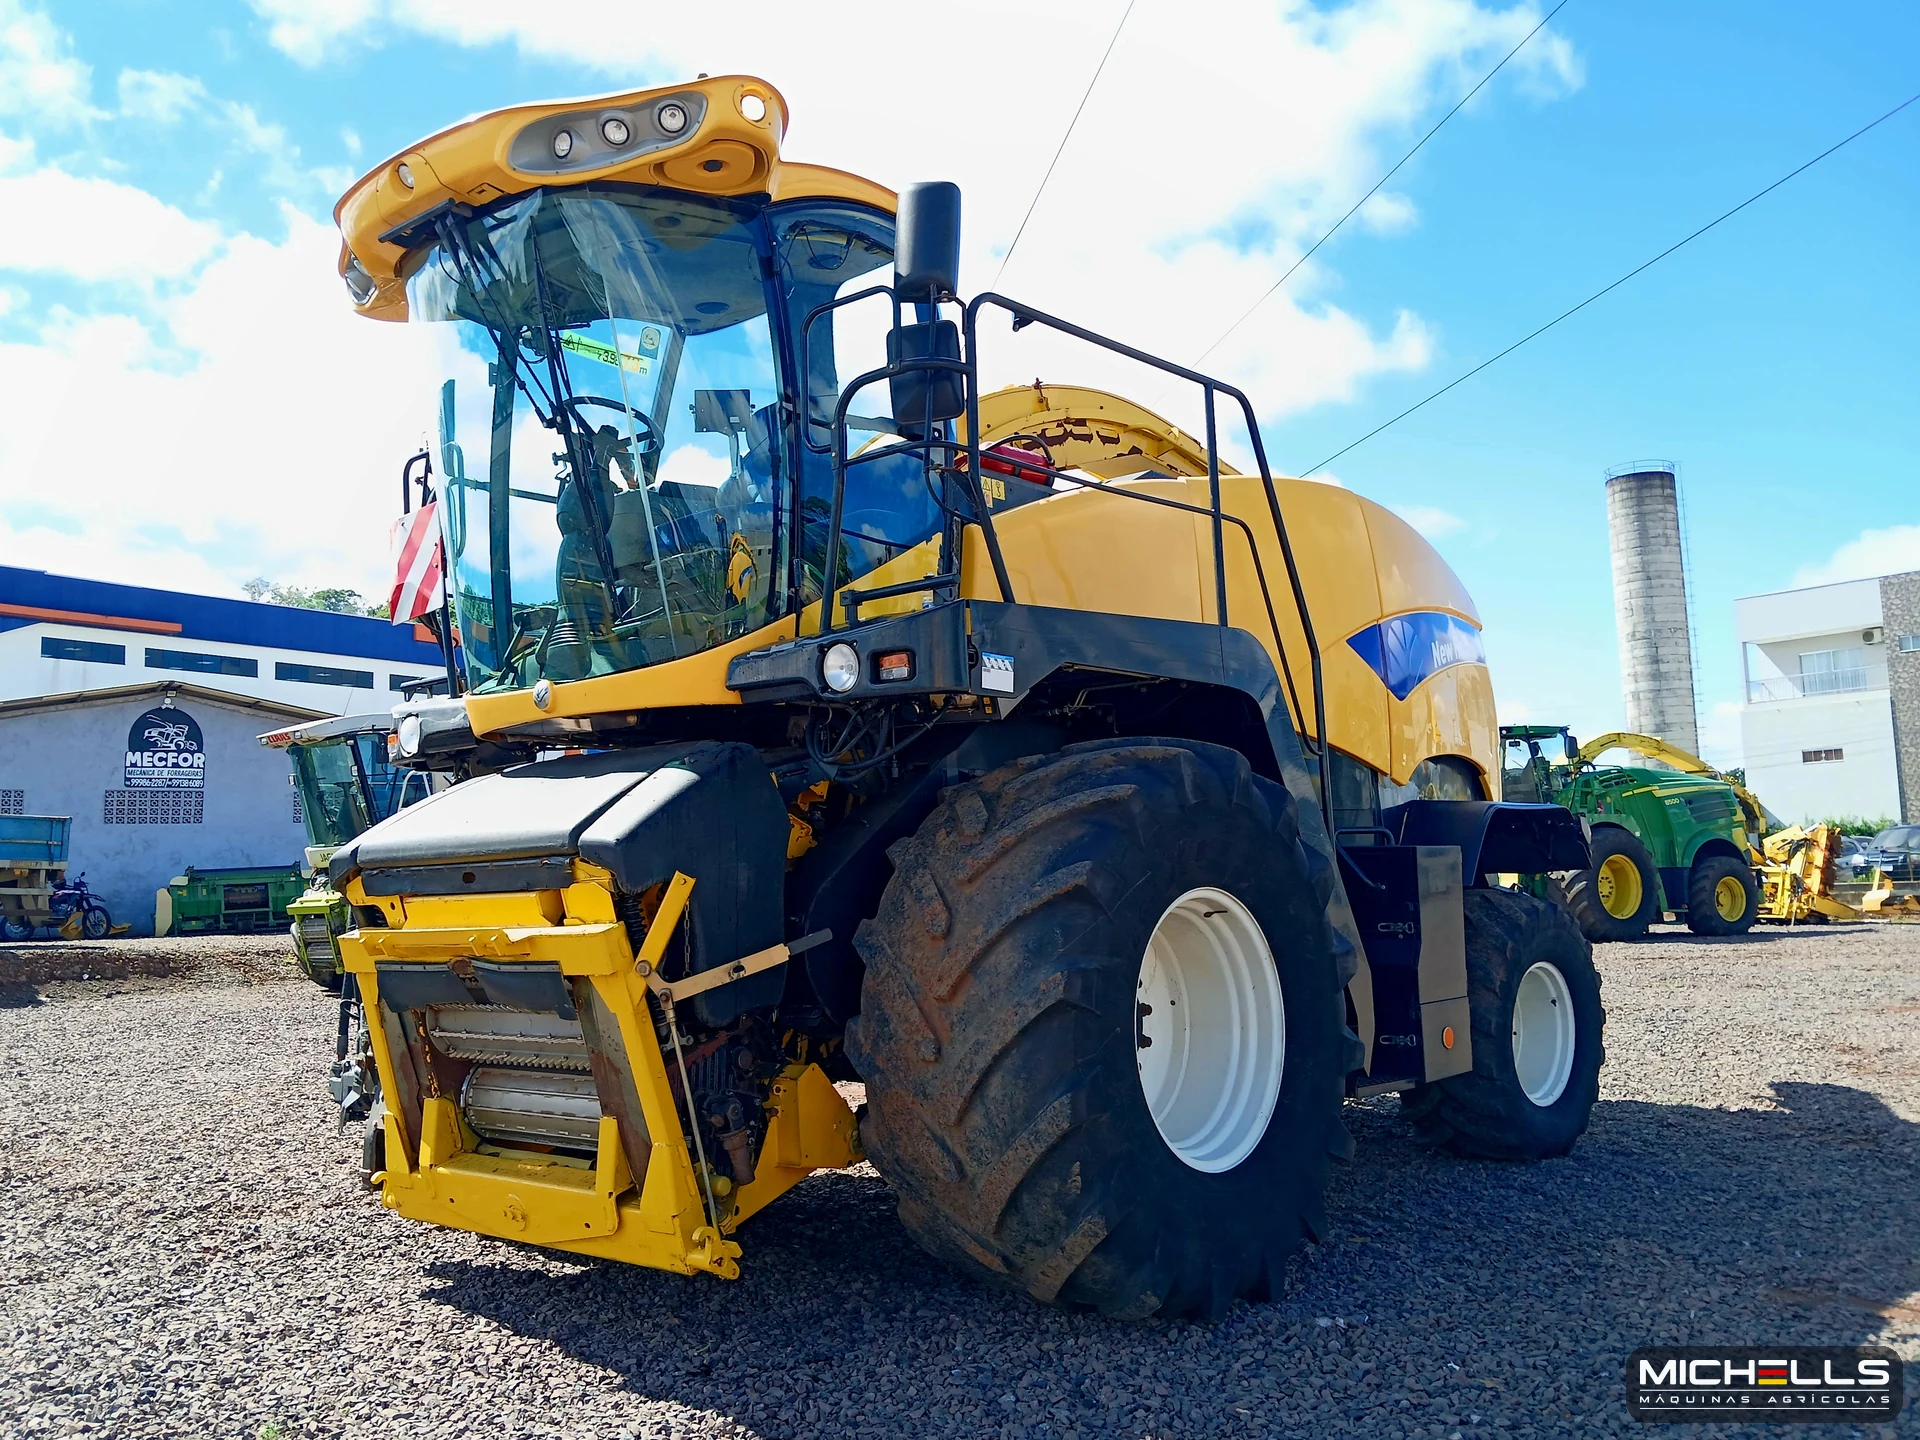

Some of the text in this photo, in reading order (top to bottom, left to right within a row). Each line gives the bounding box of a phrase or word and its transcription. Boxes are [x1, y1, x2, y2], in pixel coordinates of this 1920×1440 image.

[1431, 640, 1453, 668] New
[126, 752, 205, 768] MECFOR
[167, 769, 203, 777] FORRAGEIRAS
